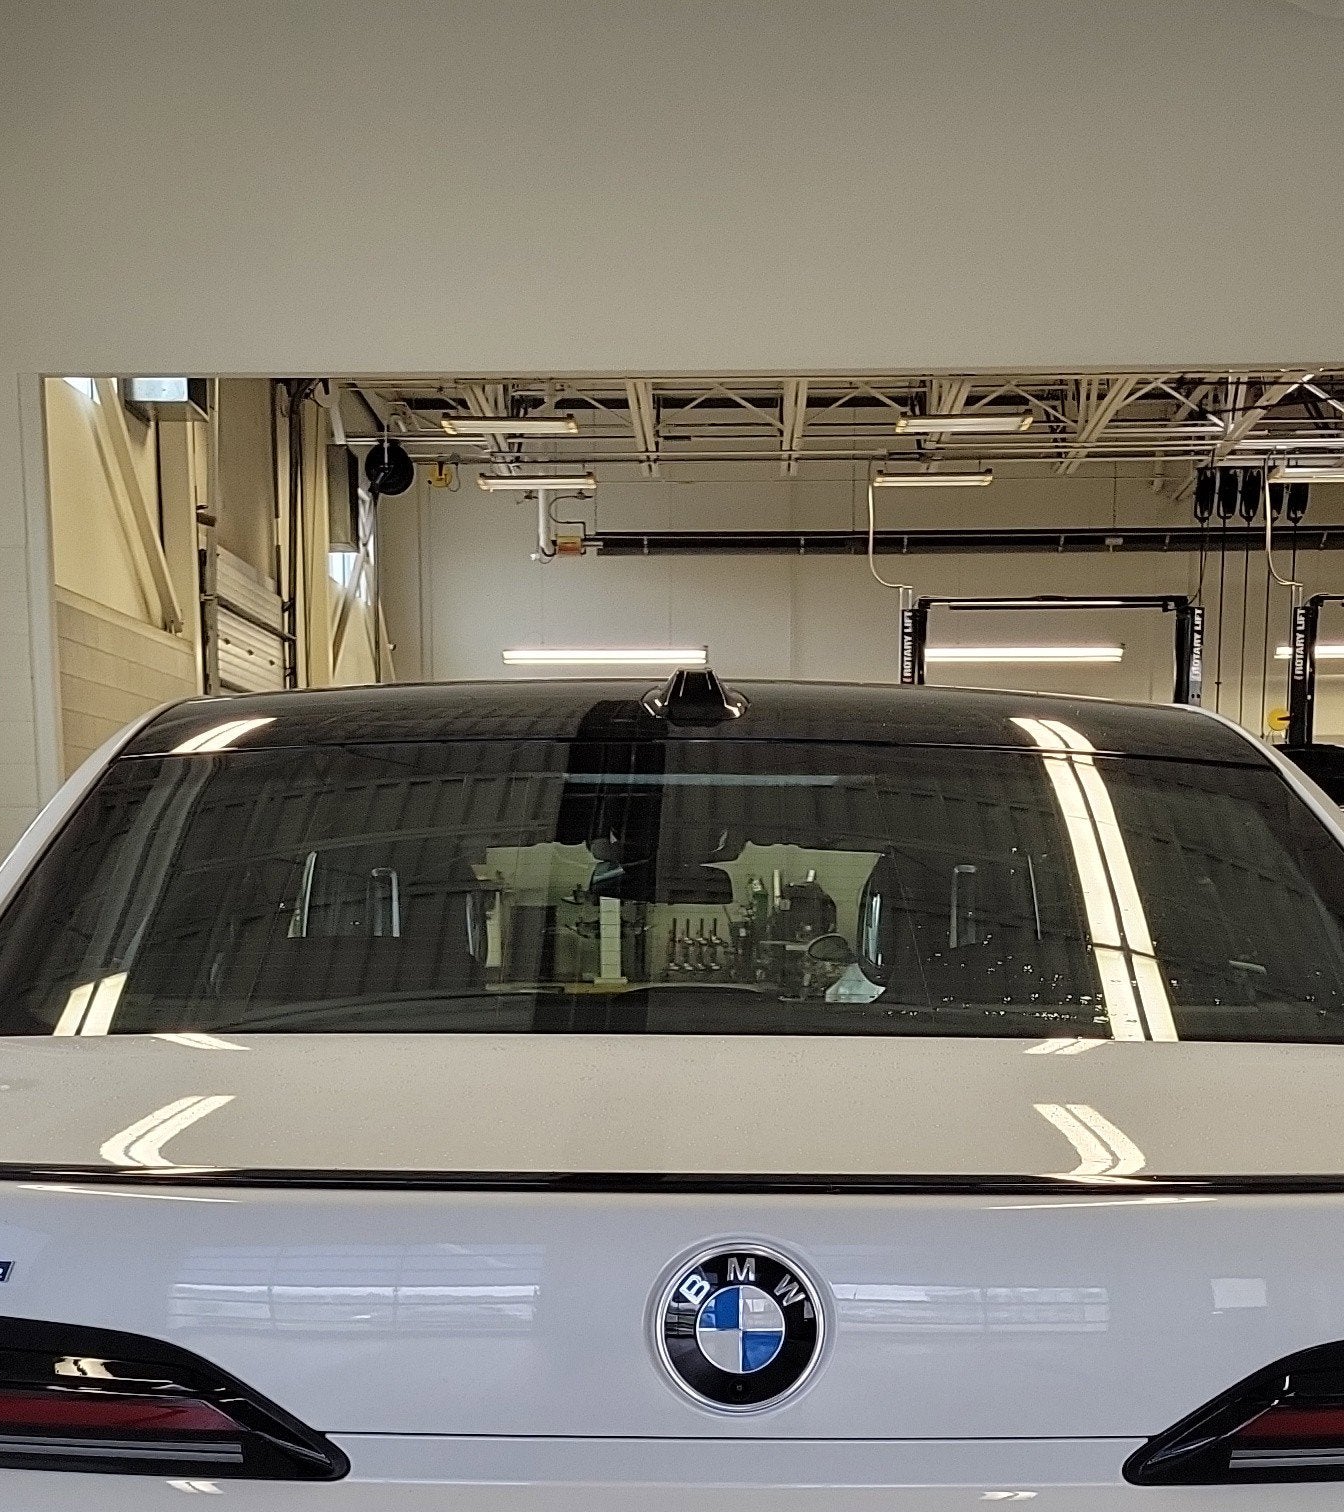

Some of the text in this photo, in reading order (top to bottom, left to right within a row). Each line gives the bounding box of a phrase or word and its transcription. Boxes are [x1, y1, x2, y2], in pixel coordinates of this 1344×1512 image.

[903, 610, 913, 677] ROTARY LIFT
[1294, 608, 1306, 675] ROTARY LIFT
[679, 1257, 806, 1308] BMW
